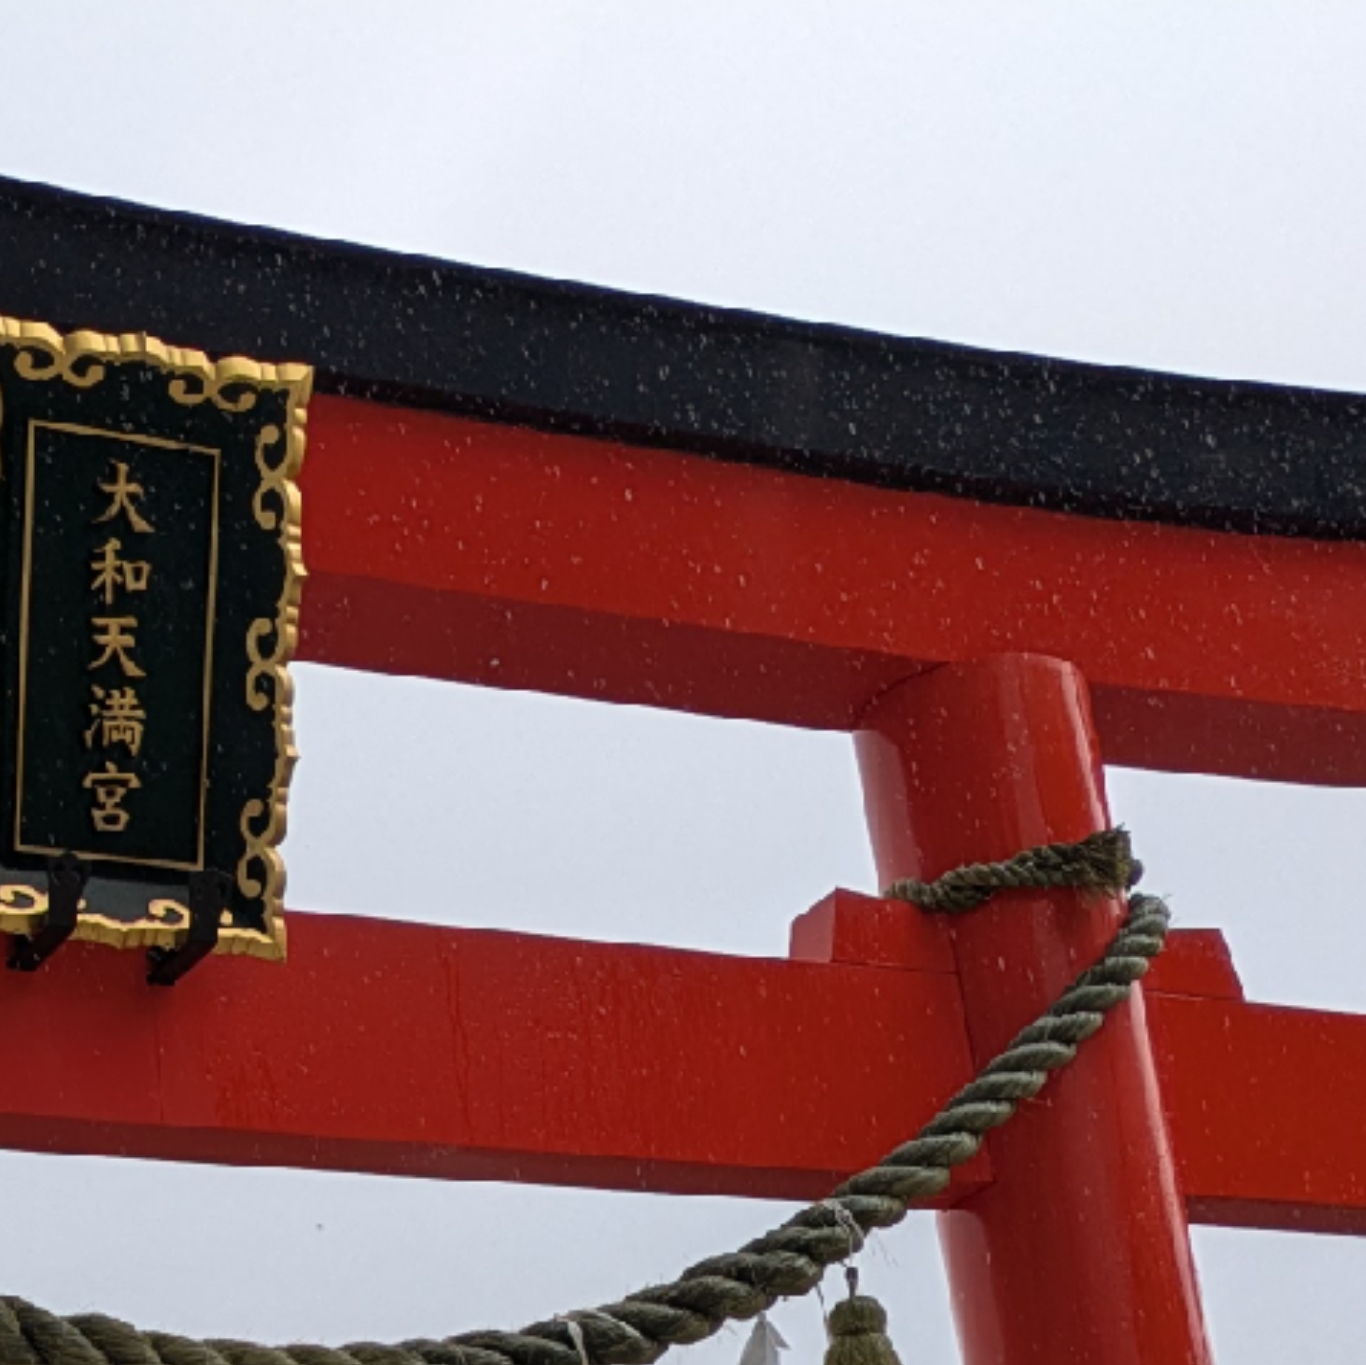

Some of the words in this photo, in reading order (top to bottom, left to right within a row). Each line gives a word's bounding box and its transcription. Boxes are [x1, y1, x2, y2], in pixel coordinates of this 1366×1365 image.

[81, 460, 156, 832] 大和天満宮
